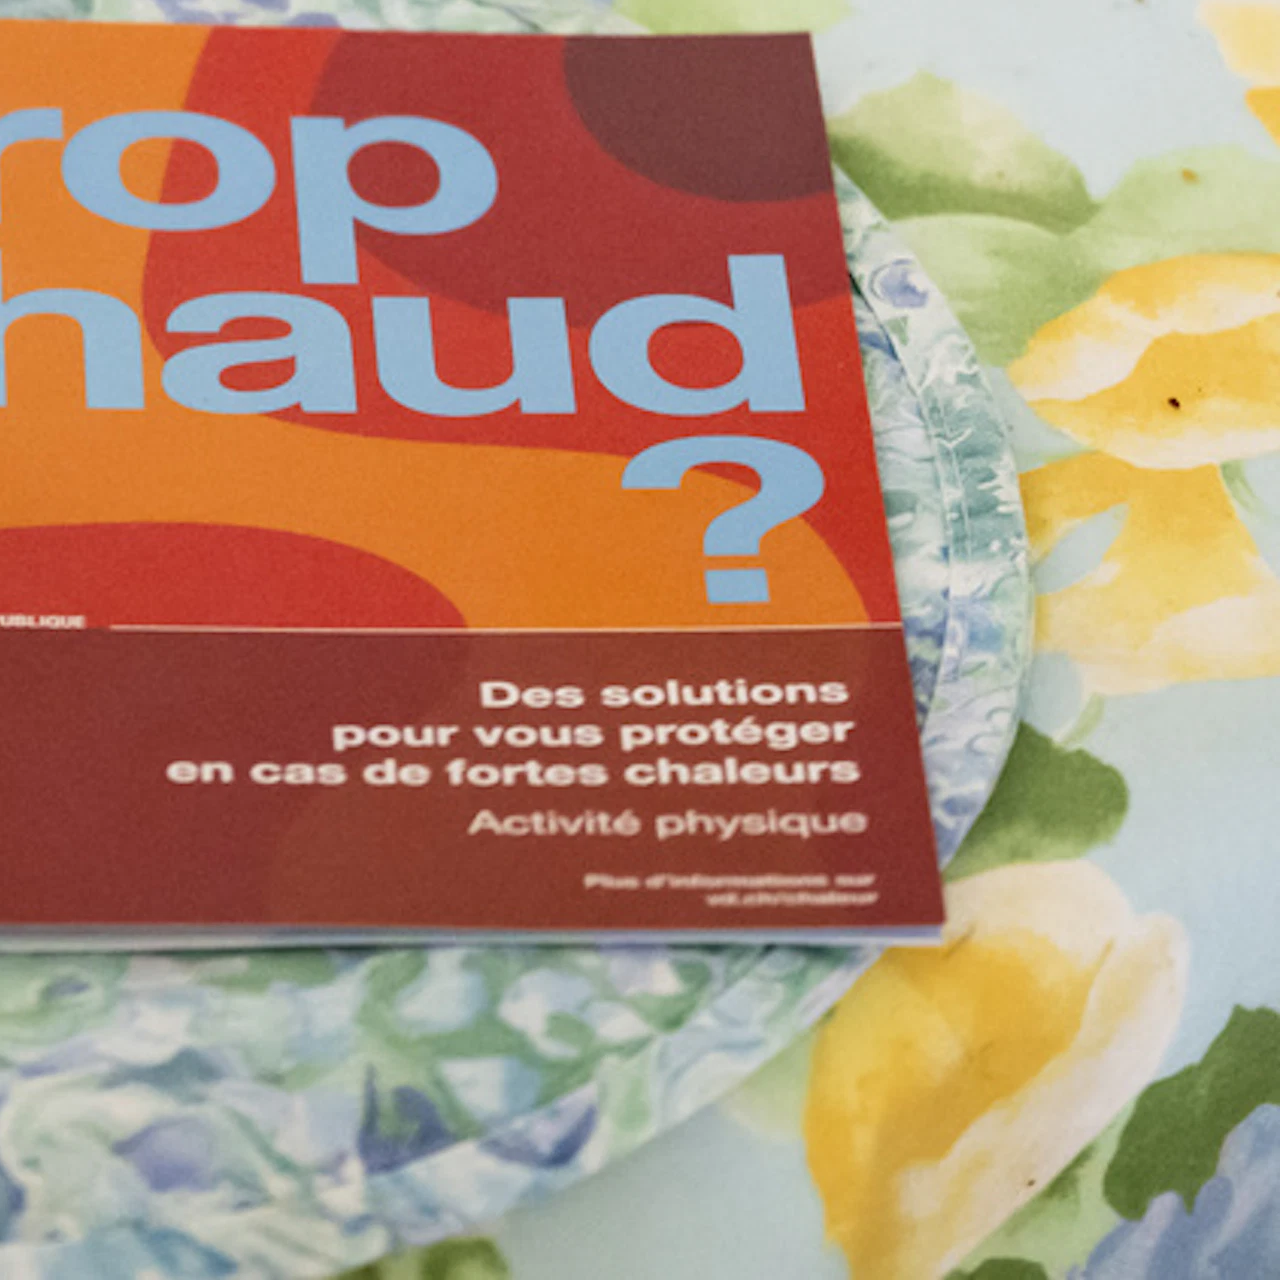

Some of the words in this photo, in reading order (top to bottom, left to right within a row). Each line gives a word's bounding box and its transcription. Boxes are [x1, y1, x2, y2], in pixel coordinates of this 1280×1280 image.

[620, 435, 826, 604] ?
[479, 681, 585, 708] Des
[600, 678, 850, 707] solutions
[332, 724, 460, 752] pour
[473, 724, 604, 747] vous
[620, 716, 856, 752] protéger
[166, 760, 235, 785] en
[249, 761, 348, 786] cas
[362, 757, 432, 786] de
[446, 757, 609, 787] fortes
[623, 756, 861, 787] chaleurs
[466, 808, 641, 837] Activité
[654, 807, 869, 841] physique
